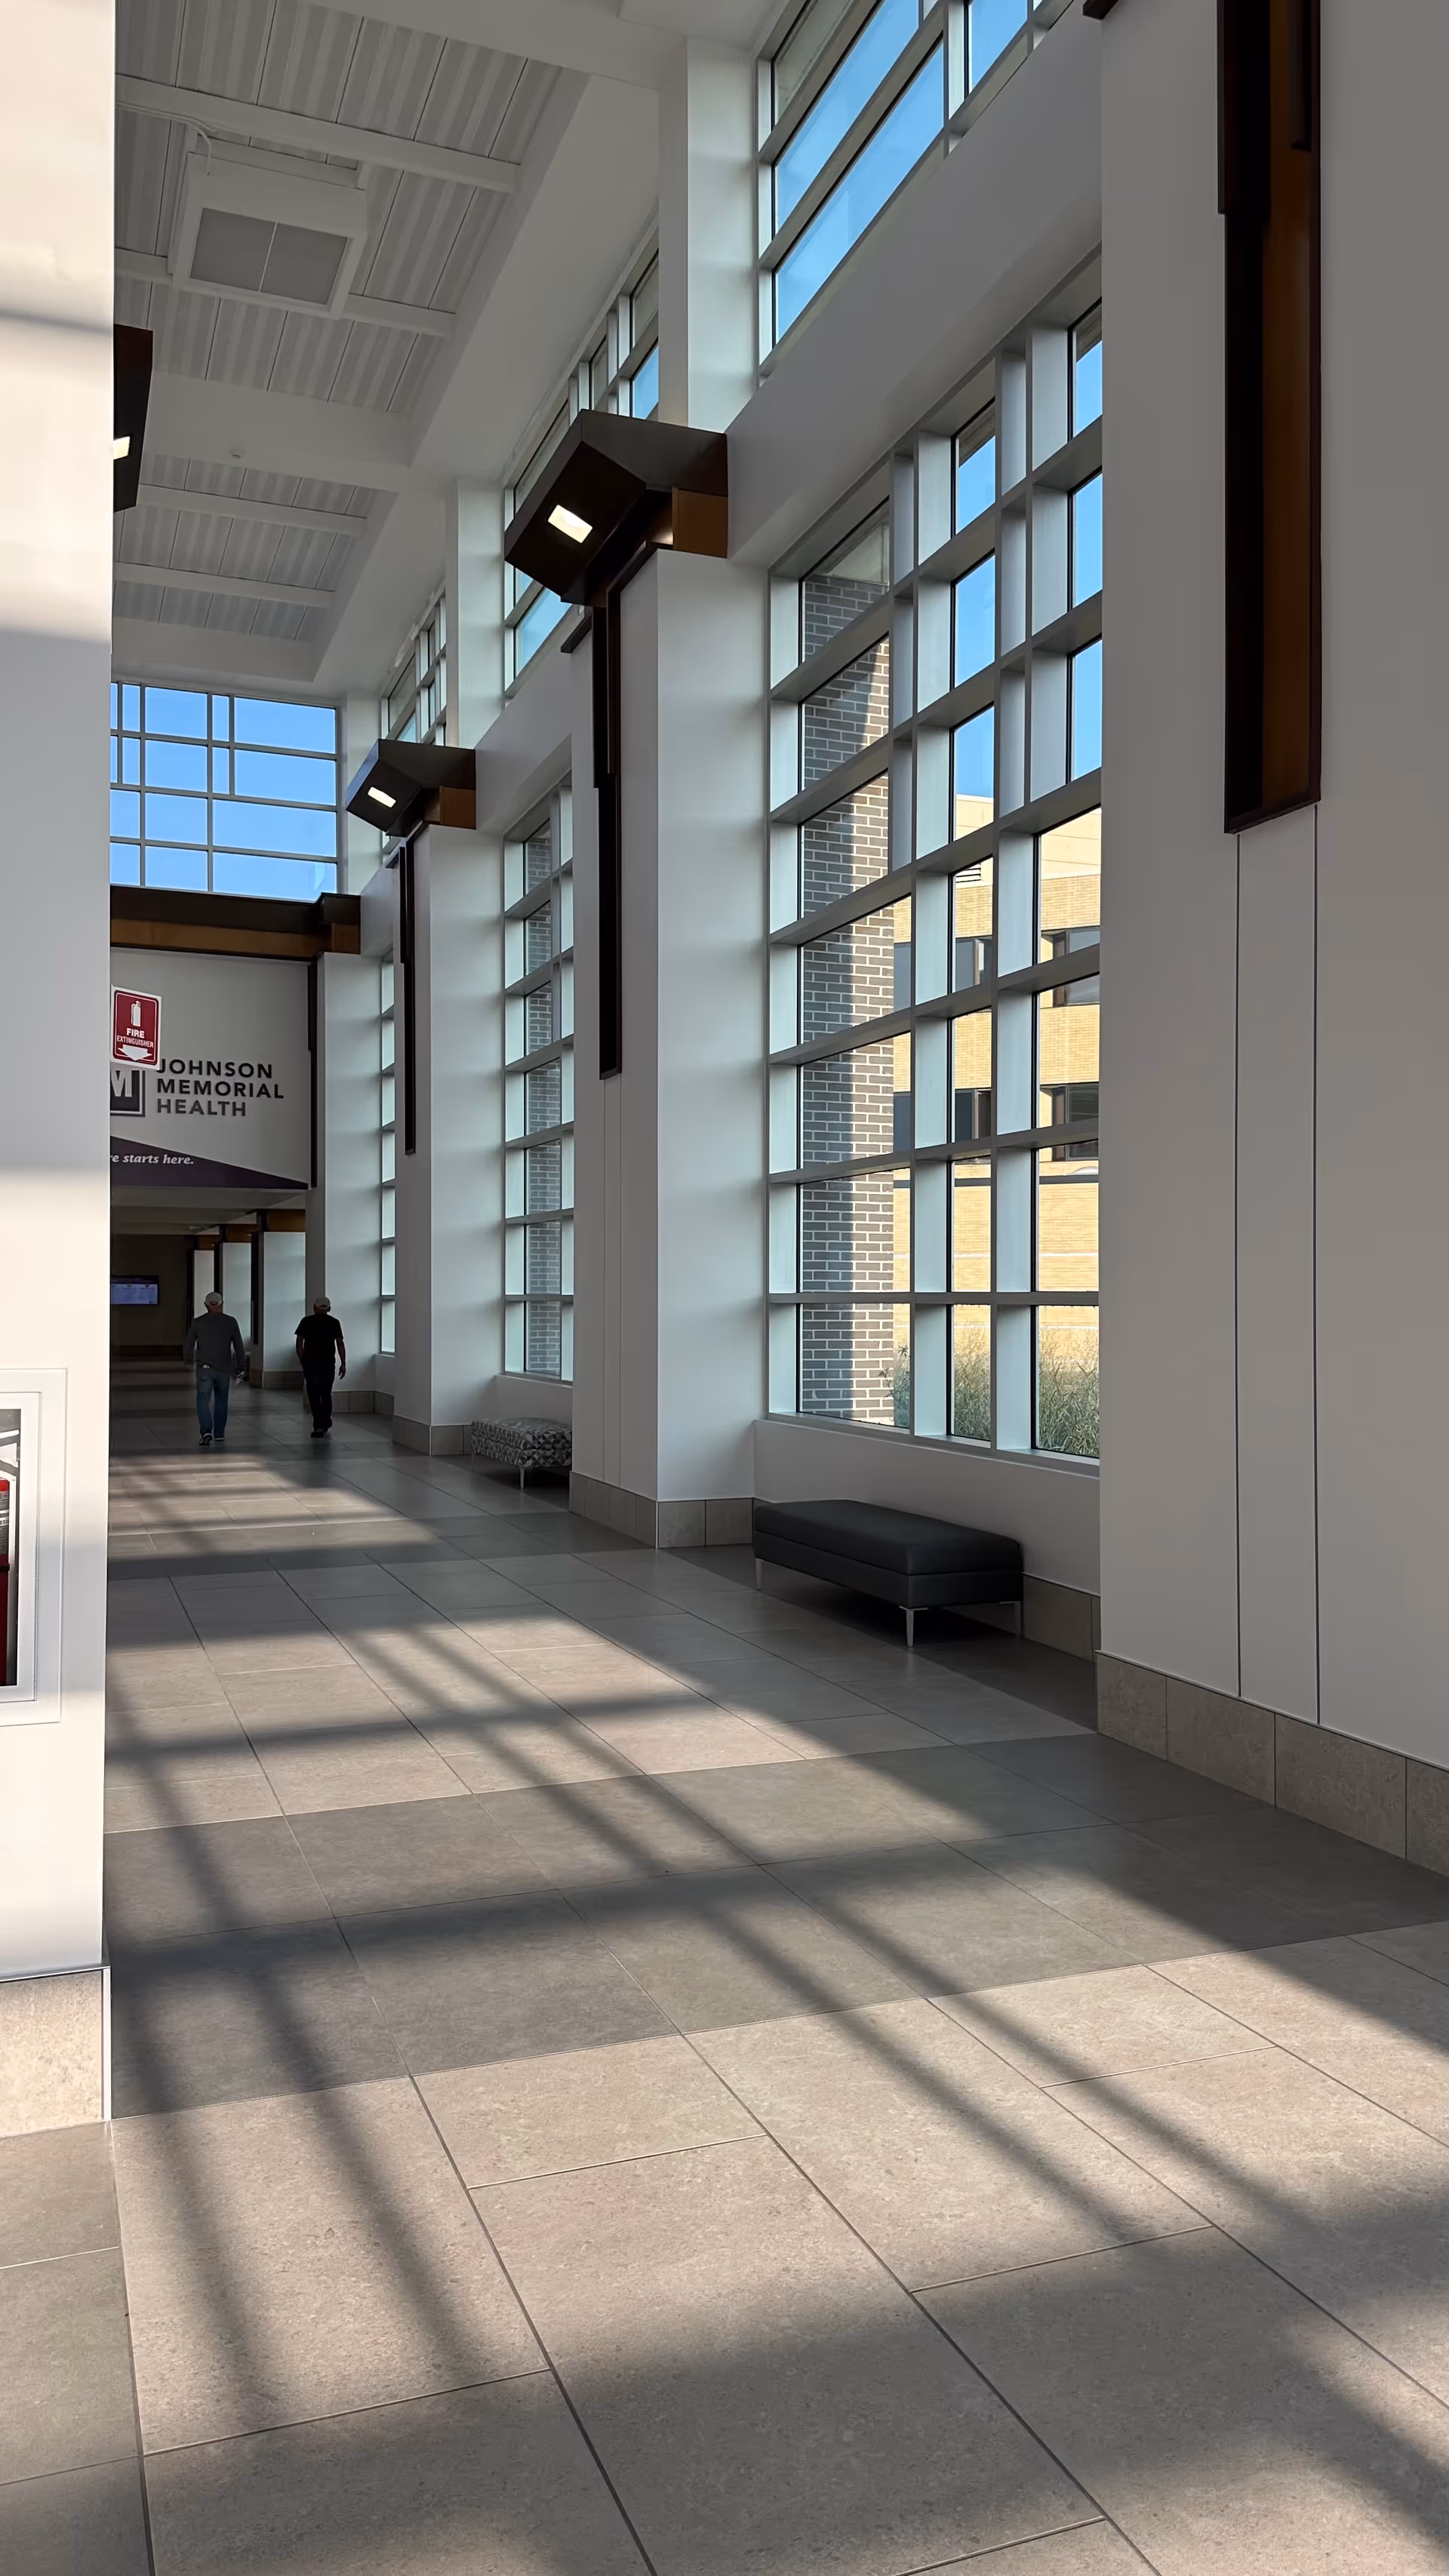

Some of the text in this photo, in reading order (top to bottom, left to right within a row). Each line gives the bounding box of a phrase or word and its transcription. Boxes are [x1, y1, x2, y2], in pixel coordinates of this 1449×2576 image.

[126, 1027, 145, 1039] FIRE
[116, 1035, 154, 1048] EXTINGUISHER
[156, 1058, 272, 1079] JOHNSON
[157, 1078, 285, 1099] MEMORIAL
[157, 1098, 246, 1117] HEALTH
[122, 1153, 159, 1164] starts
[162, 1153, 195, 1165] here.
